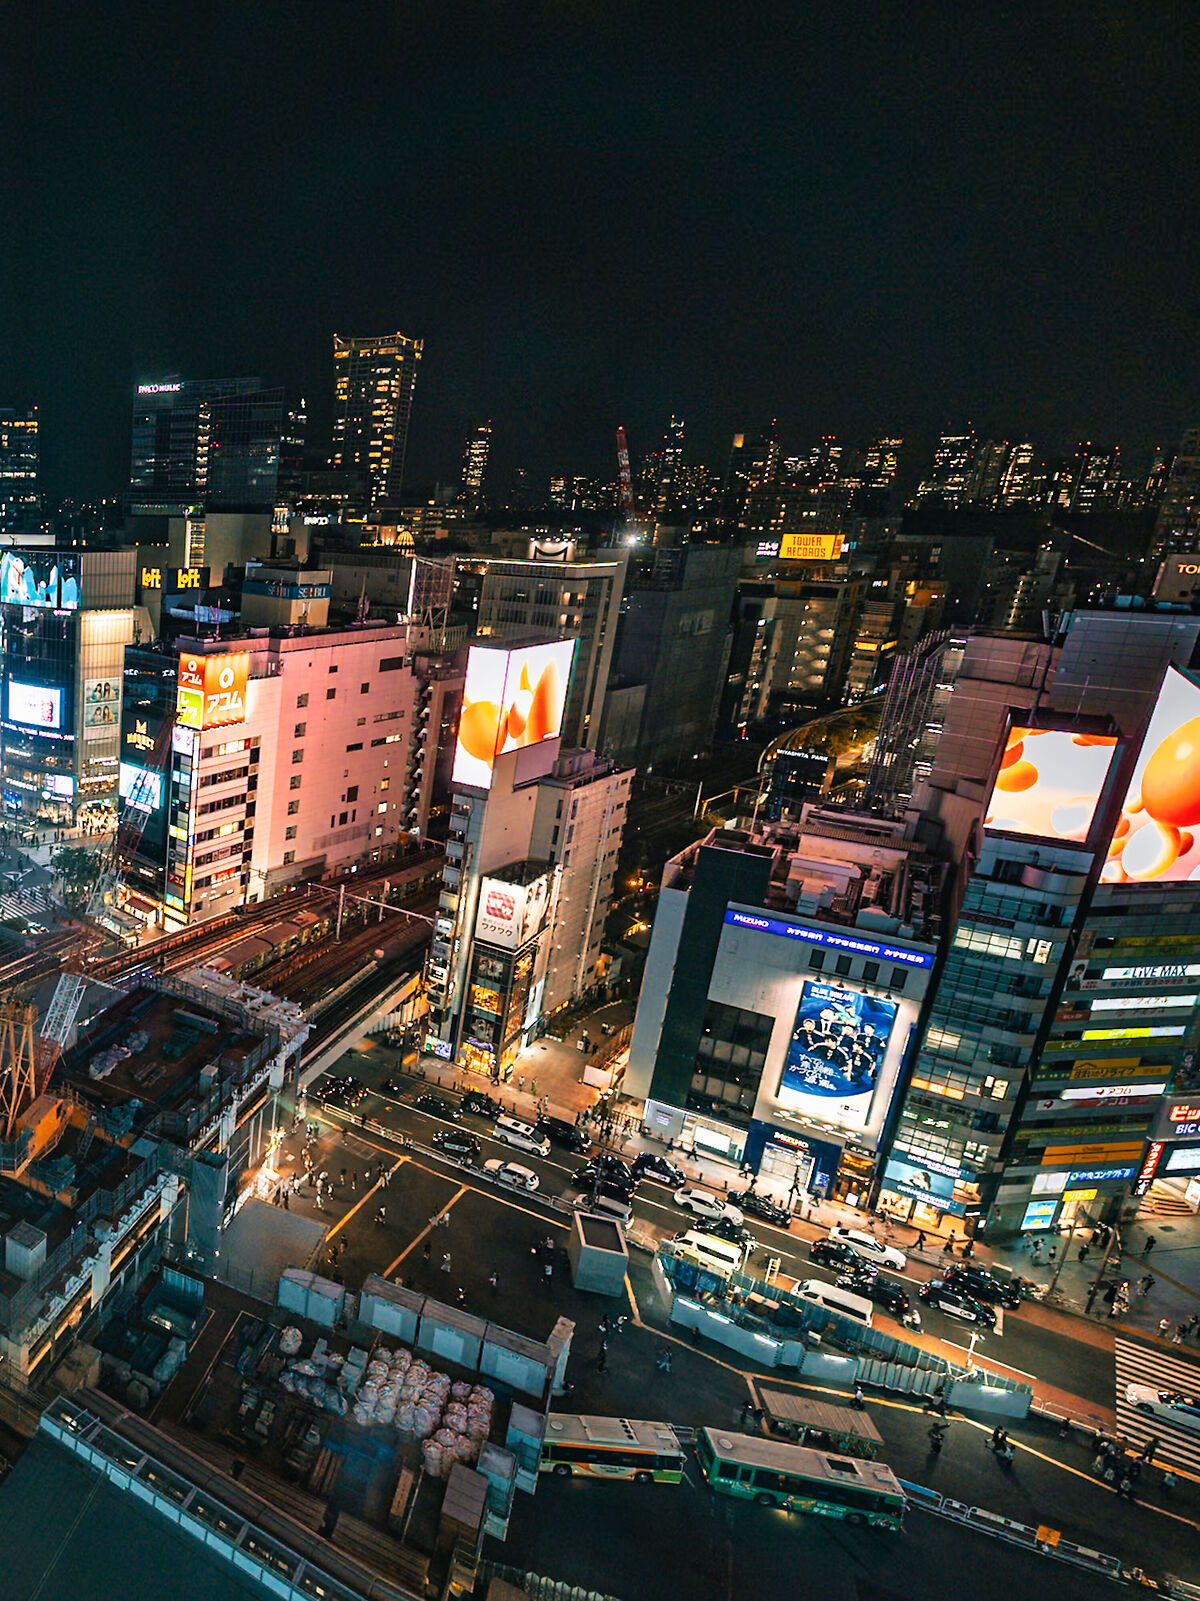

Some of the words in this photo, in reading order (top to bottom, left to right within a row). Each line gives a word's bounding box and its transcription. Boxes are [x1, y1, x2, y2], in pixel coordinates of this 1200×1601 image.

[792, 536, 822, 546] TOWER
[786, 547, 826, 557] RECORDS
[181, 671, 202, 686] アコム
[207, 690, 243, 714] アコム
[734, 913, 770, 928] MIZUHO
[481, 922, 513, 937] ワクワク
[1160, 965, 1189, 978] MAX
[1106, 1087, 1132, 1095] アコム
[1175, 1123, 1197, 1135] BIC
[773, 1132, 809, 1148] MIZUHO
